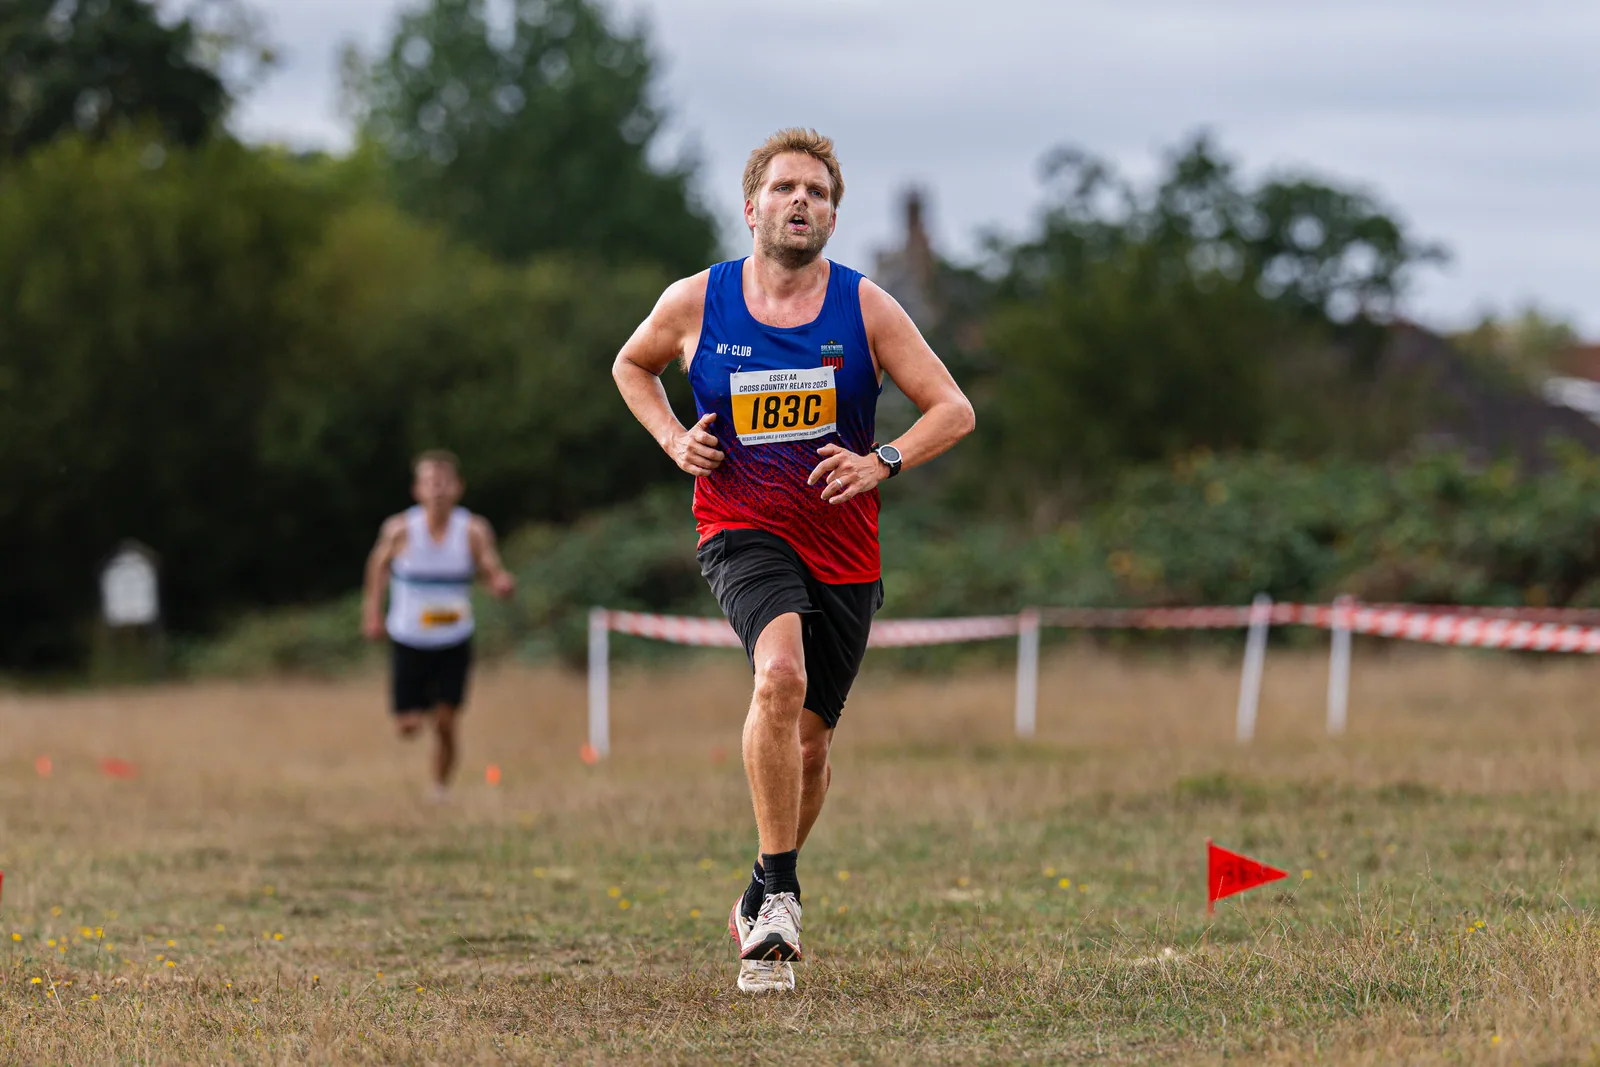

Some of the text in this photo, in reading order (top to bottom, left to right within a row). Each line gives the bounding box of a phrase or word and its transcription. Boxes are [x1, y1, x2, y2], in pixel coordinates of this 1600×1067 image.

[769, 373, 797, 382] ESSEX AA
[739, 380, 828, 393] CROSS COUNTRY RELAYS 2026
[751, 394, 822, 430] 183C
